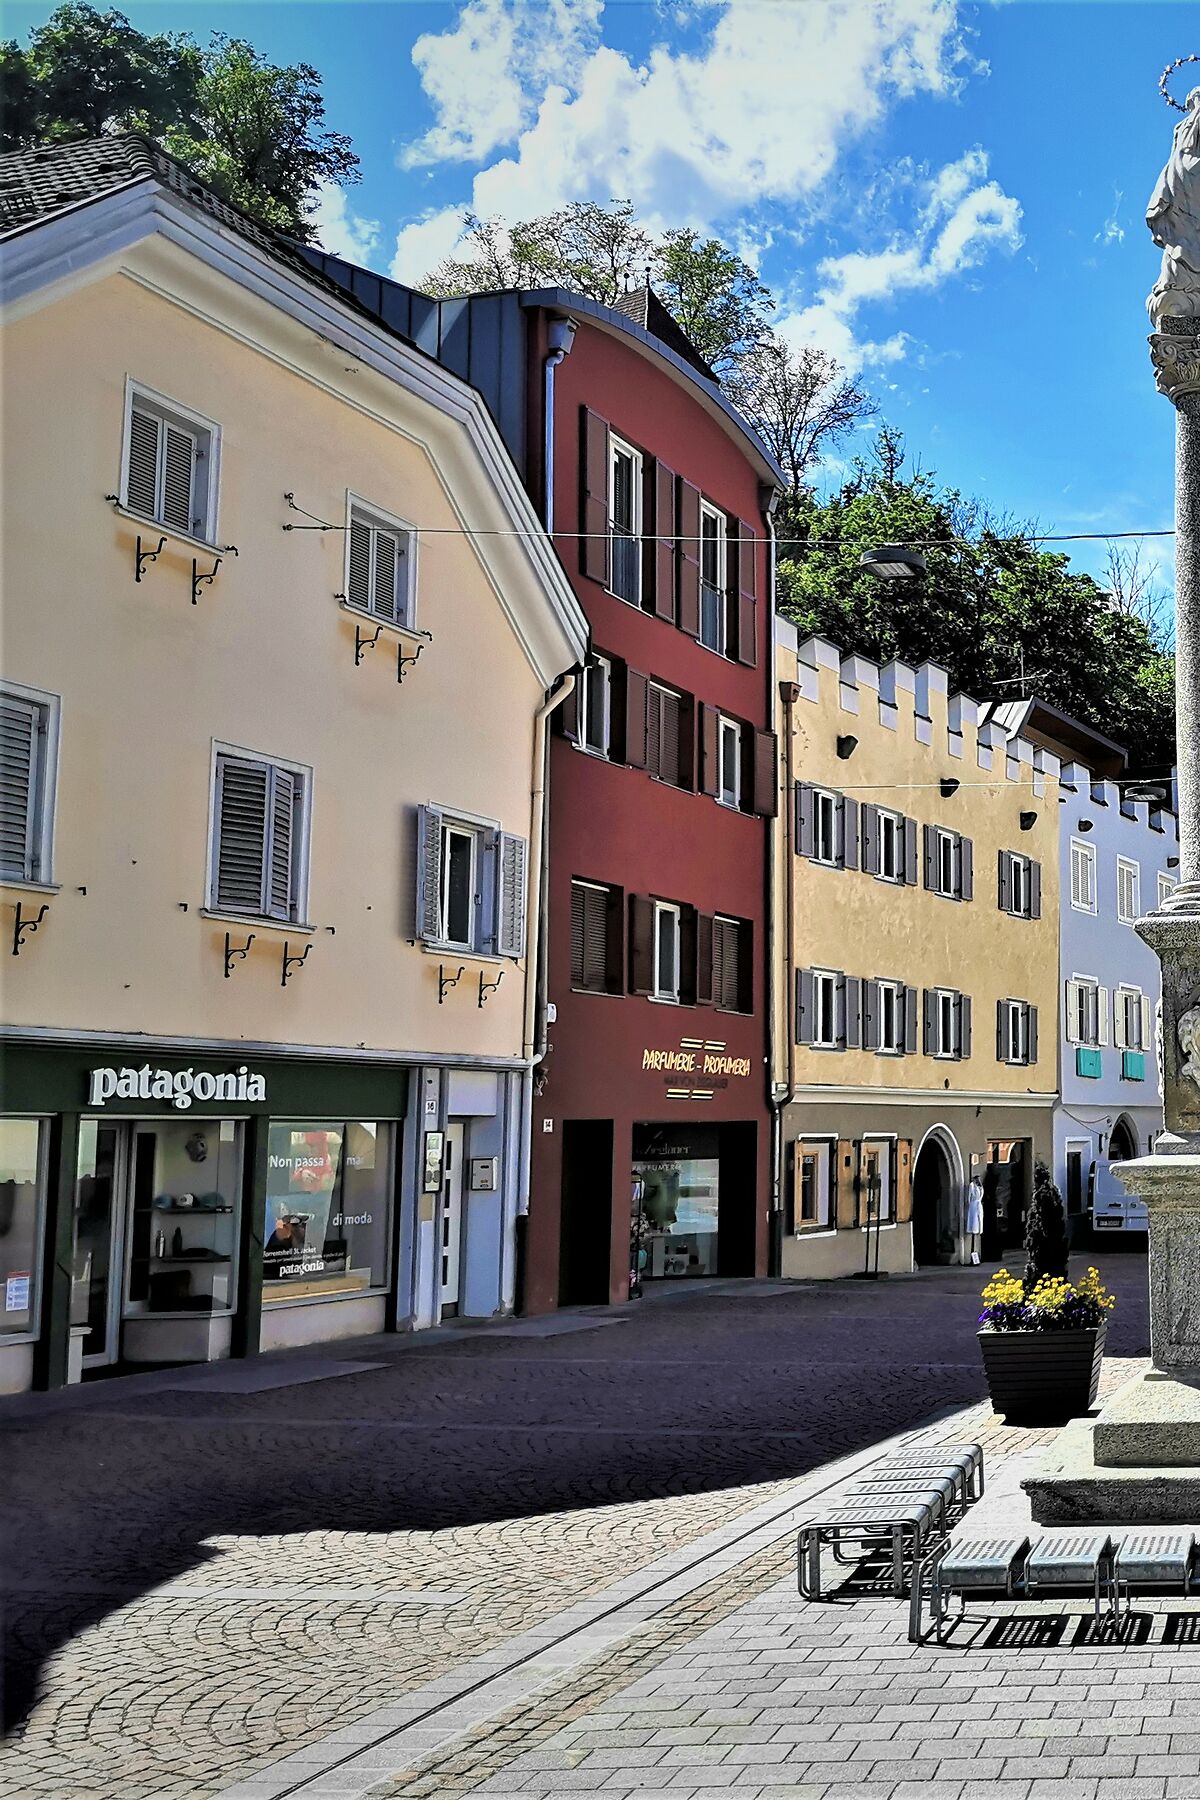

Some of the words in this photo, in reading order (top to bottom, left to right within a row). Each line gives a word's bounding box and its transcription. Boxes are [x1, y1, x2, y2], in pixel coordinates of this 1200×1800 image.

[642, 1048, 696, 1072] PARFUMERIE
[703, 1054, 751, 1077] PROFUMERIA
[89, 1063, 267, 1109] patagonia
[269, 1155, 292, 1168] Non
[295, 1156, 324, 1168] passa
[332, 1213, 343, 1226] di
[345, 1211, 373, 1225] moda
[279, 1260, 325, 1277] patagonia
